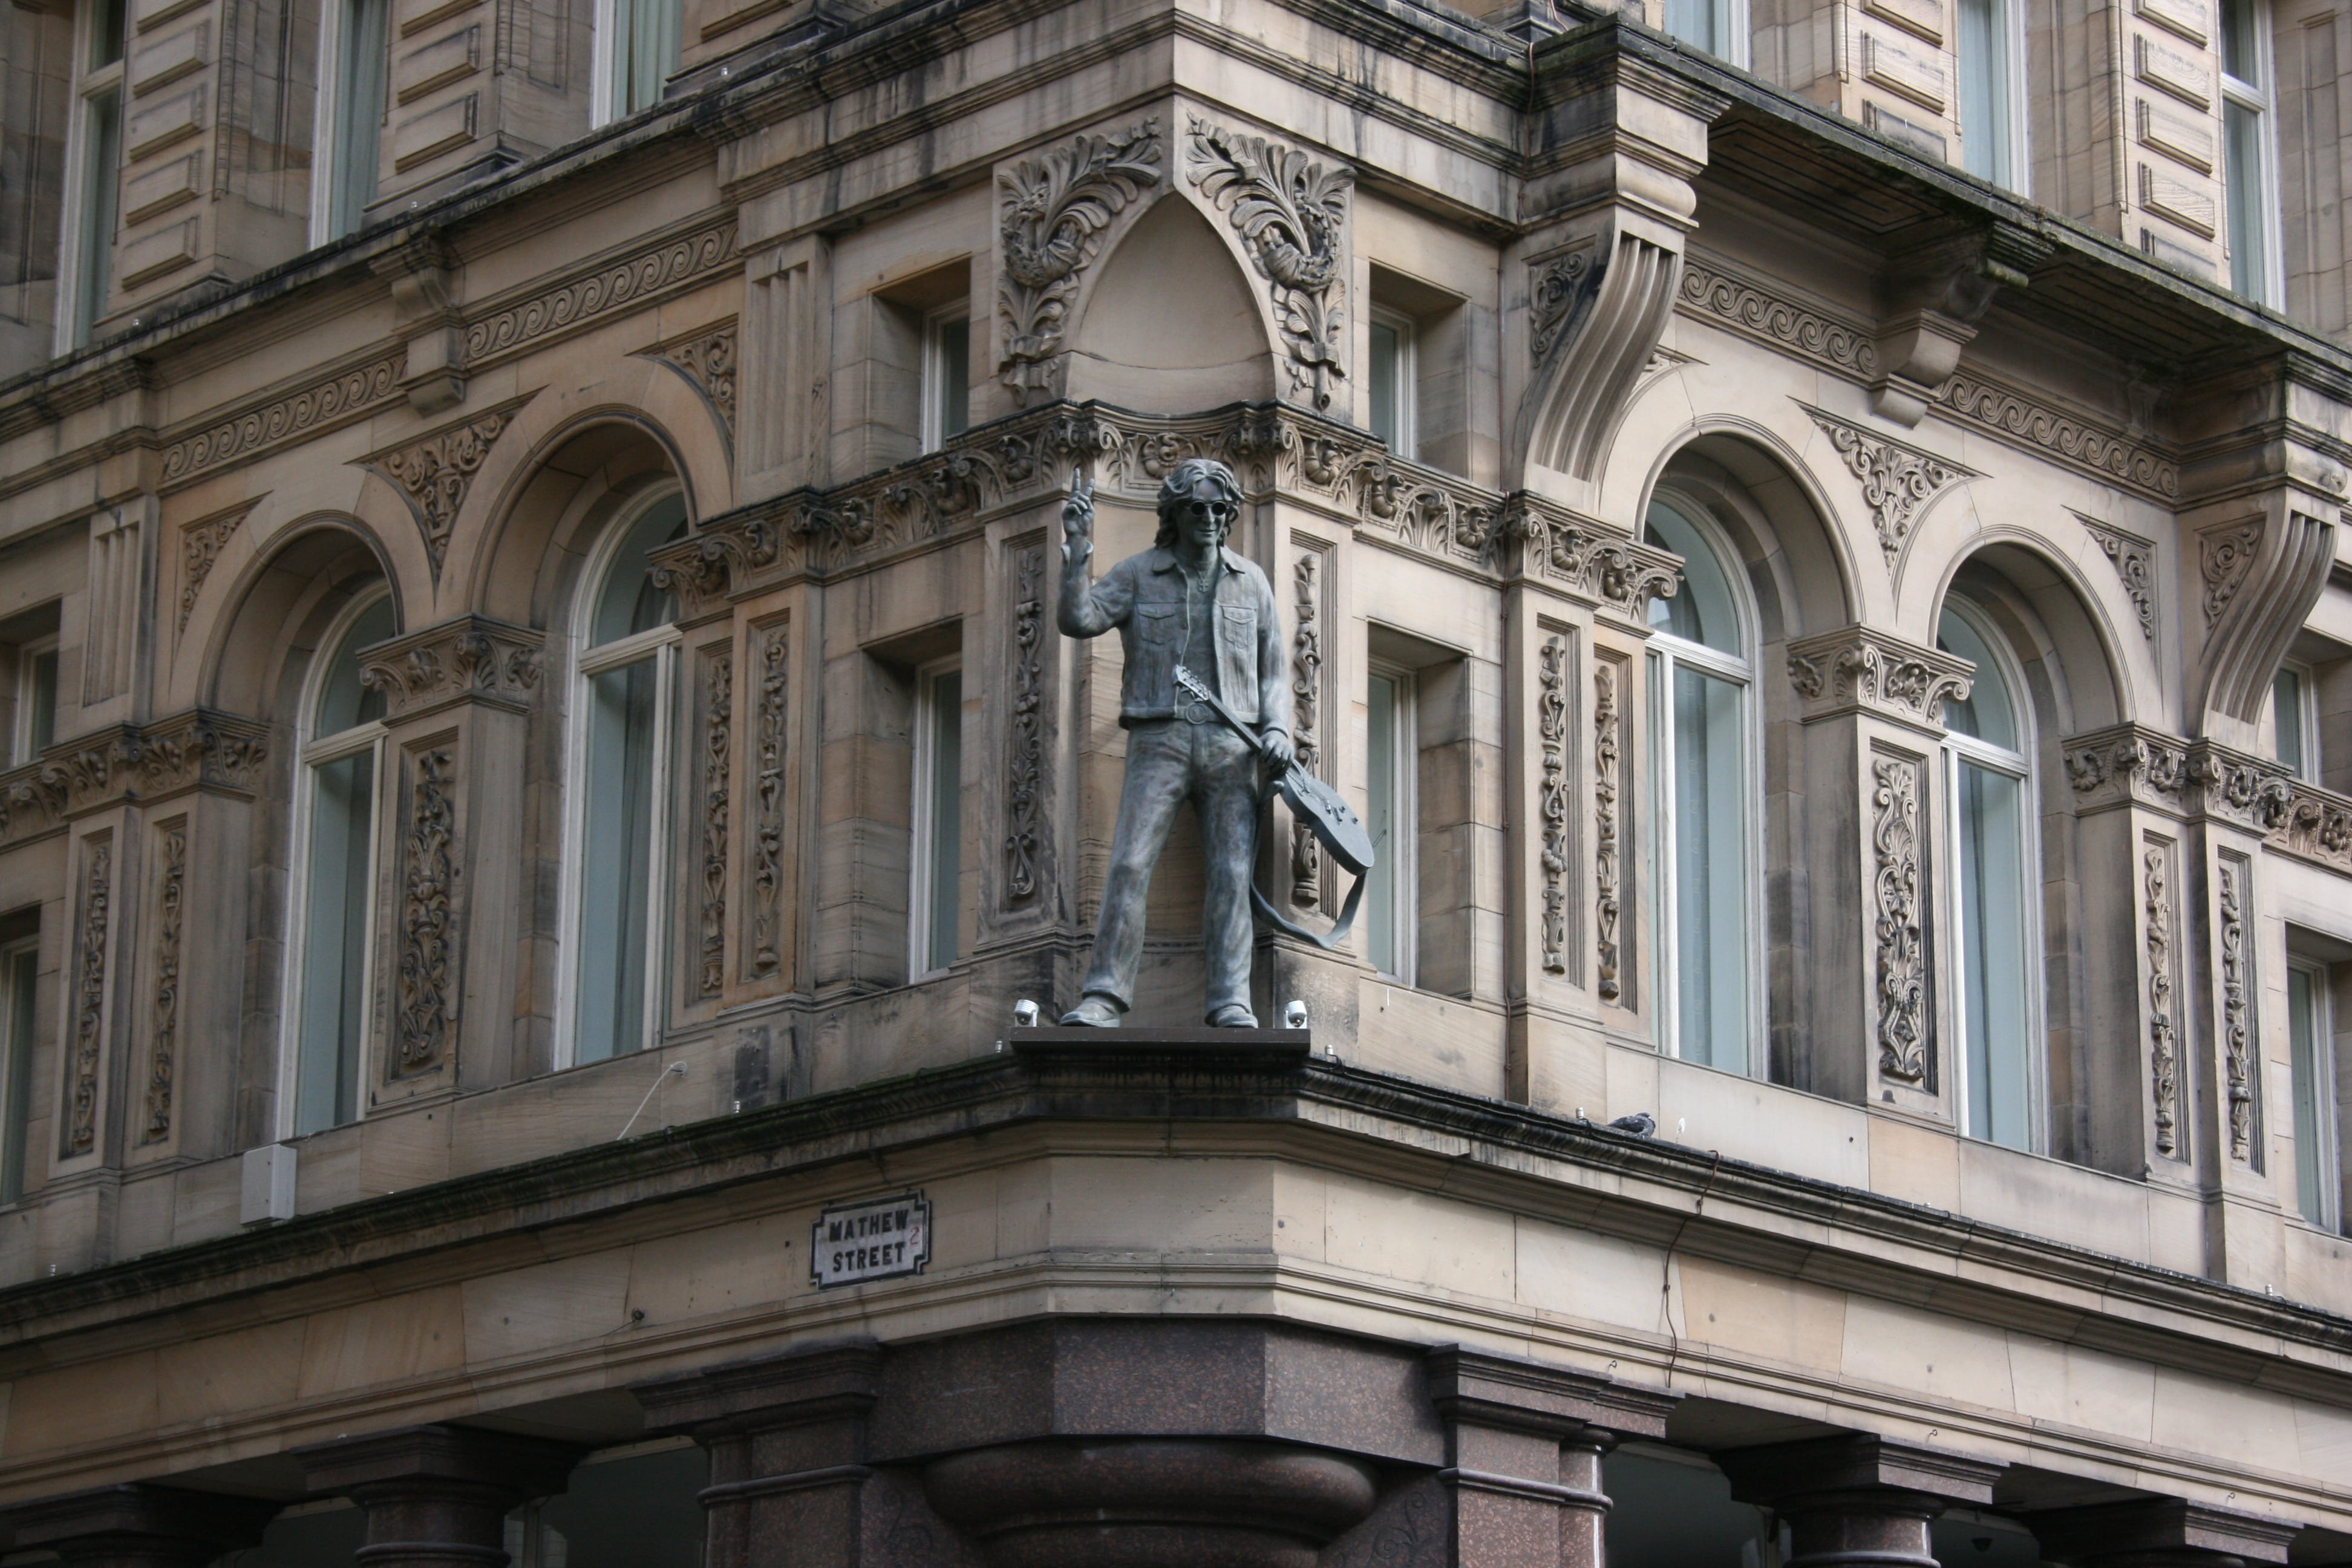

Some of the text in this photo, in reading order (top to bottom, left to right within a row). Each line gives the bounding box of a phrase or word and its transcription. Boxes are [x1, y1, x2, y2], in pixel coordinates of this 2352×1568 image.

[829, 1209, 909, 1242] MATHEW
[909, 1226, 920, 1245] 2
[833, 1242, 906, 1272] STREET
